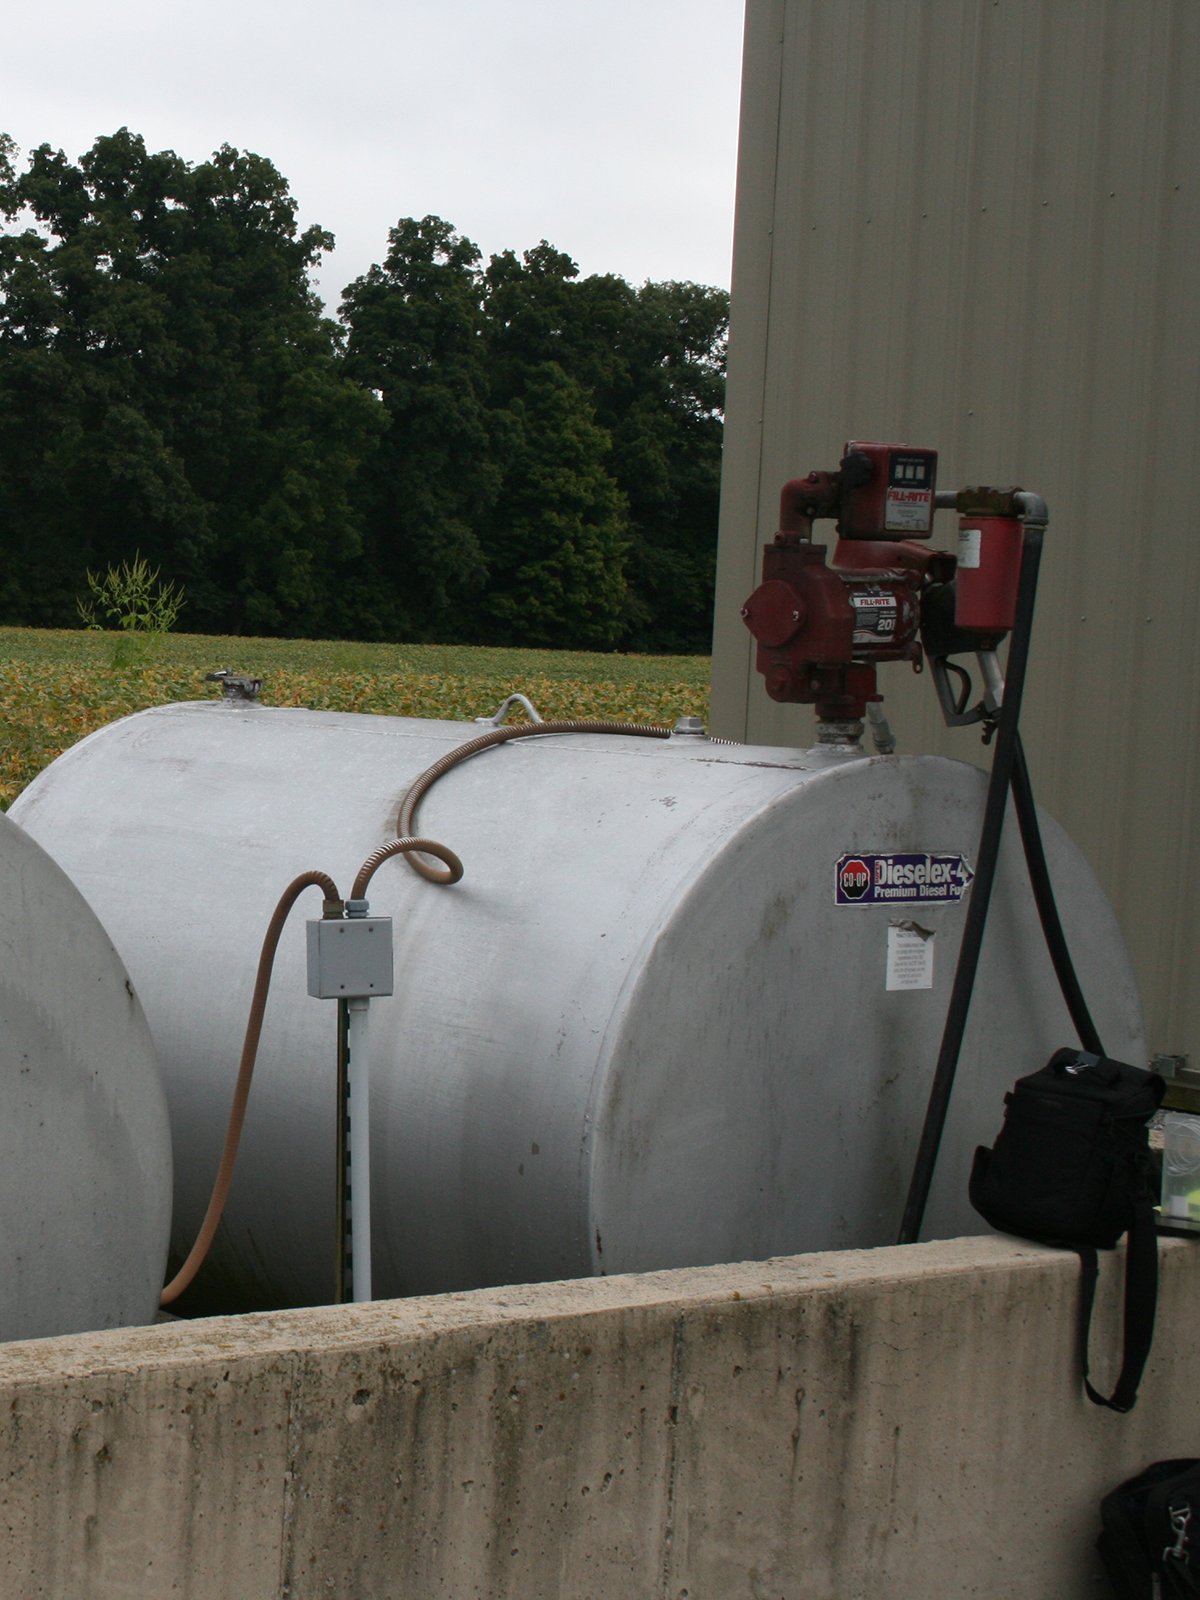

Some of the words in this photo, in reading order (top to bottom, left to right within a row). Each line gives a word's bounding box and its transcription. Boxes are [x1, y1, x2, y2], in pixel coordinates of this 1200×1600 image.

[888, 491, 931, 502] FILL-RITE
[860, 598, 890, 606] FILL-RITE
[874, 859, 968, 885] Dieselex-4
[844, 872, 867, 887] CO-OP
[874, 885, 917, 898] Premium
[920, 884, 947, 896] Diesel
[949, 884, 961, 896] Fu
